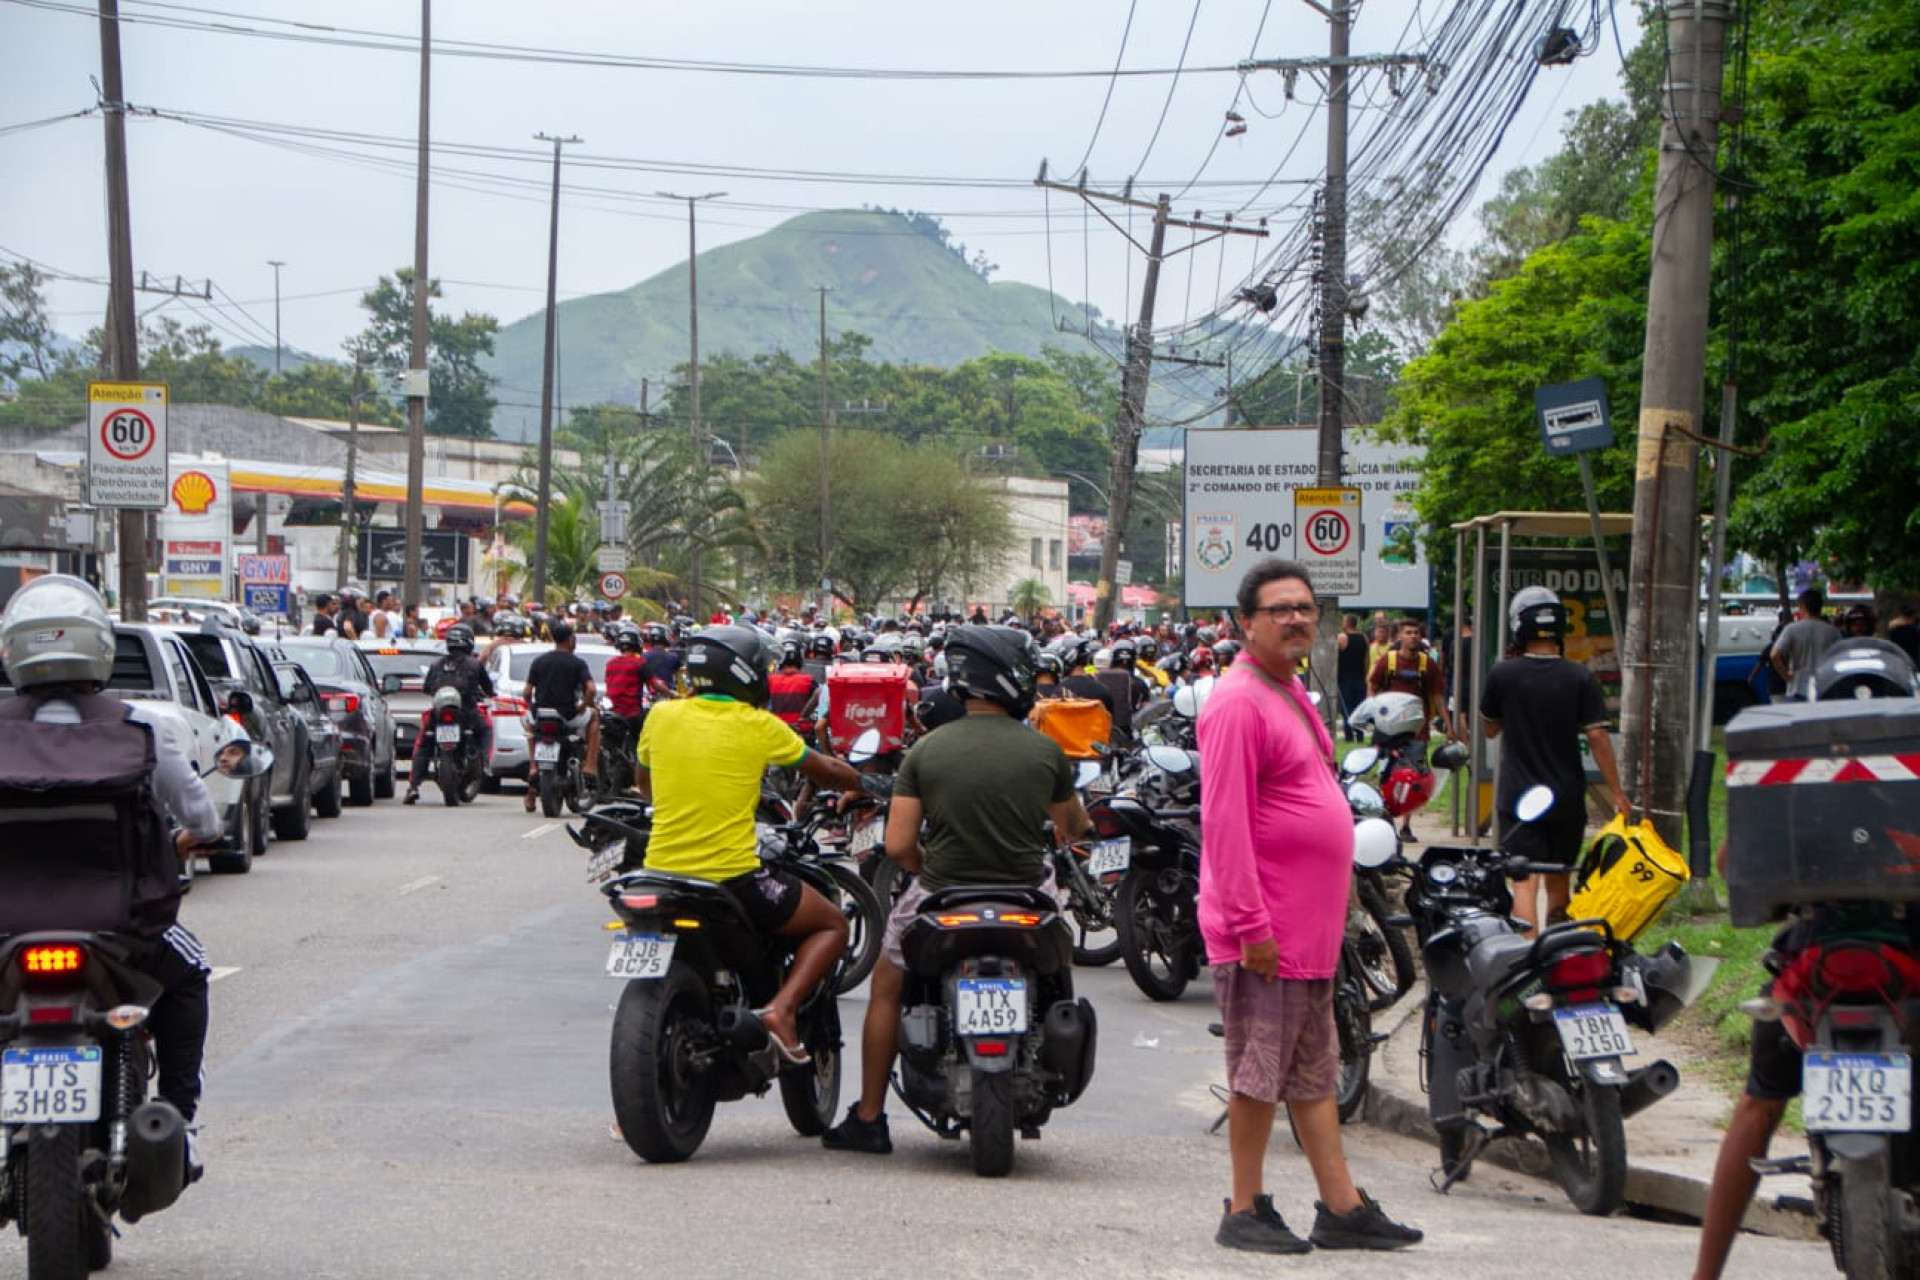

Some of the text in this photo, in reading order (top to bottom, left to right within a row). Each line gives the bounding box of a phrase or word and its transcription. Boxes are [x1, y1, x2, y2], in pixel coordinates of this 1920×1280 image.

[94, 389, 142, 400] Atenção
[113, 416, 144, 443] 60
[92, 463, 164, 476] Fiscalização
[1190, 464, 1255, 476] SECRETARIA
[1258, 464, 1272, 475] DE
[1274, 464, 1316, 475] ESTADO
[91, 477, 165, 488] Eletrônica de
[1203, 483, 1262, 492] COMANDO
[1265, 483, 1281, 492] DE
[1375, 482, 1391, 491] DE
[97, 489, 159, 500] Velocidade
[1299, 493, 1340, 504] Atenção
[1246, 522, 1292, 552] 40º
[1315, 518, 1341, 541] 60
[179, 563, 210, 573] GNV
[243, 558, 284, 579] GNV
[605, 578, 623, 590] 60
[1545, 569, 1581, 593] DO
[1630, 861, 1654, 882] 99
[623, 941, 659, 957] RJB
[613, 958, 661, 972] 8C75
[973, 989, 1010, 1008] TTX
[968, 1009, 1017, 1028] 4A59
[1574, 1015, 1614, 1035] TBM
[25, 1063, 78, 1087] TTS
[1827, 1068, 1886, 1094] RKQ
[14, 1088, 87, 1115] 3H85
[1818, 1095, 1896, 1122] 2J53
